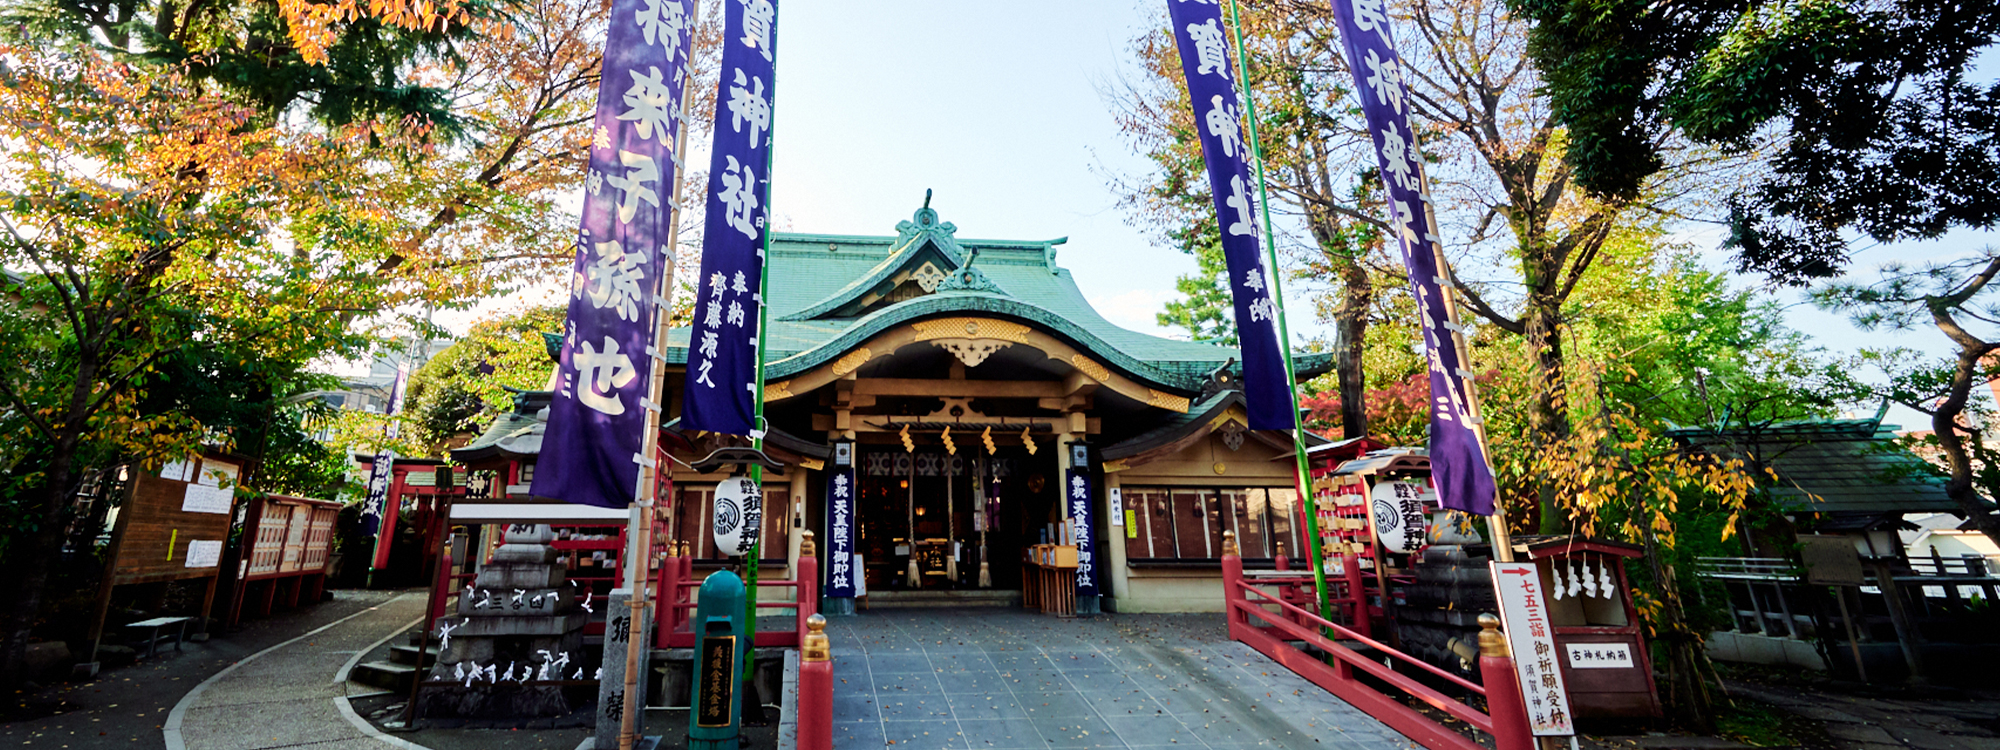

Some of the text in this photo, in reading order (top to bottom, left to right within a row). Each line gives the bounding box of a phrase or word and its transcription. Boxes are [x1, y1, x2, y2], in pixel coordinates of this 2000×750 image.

[727, 269, 748, 328] 奉納
[1071, 475, 1087, 499] 奉祝
[832, 473, 849, 589] 奉祝 天皇陛下御即位
[1073, 500, 1093, 587] 天皇陛下御即位
[1520, 579, 1564, 724] 七五三詣 御祈願受付
[1525, 664, 1547, 724] 須賀神社
